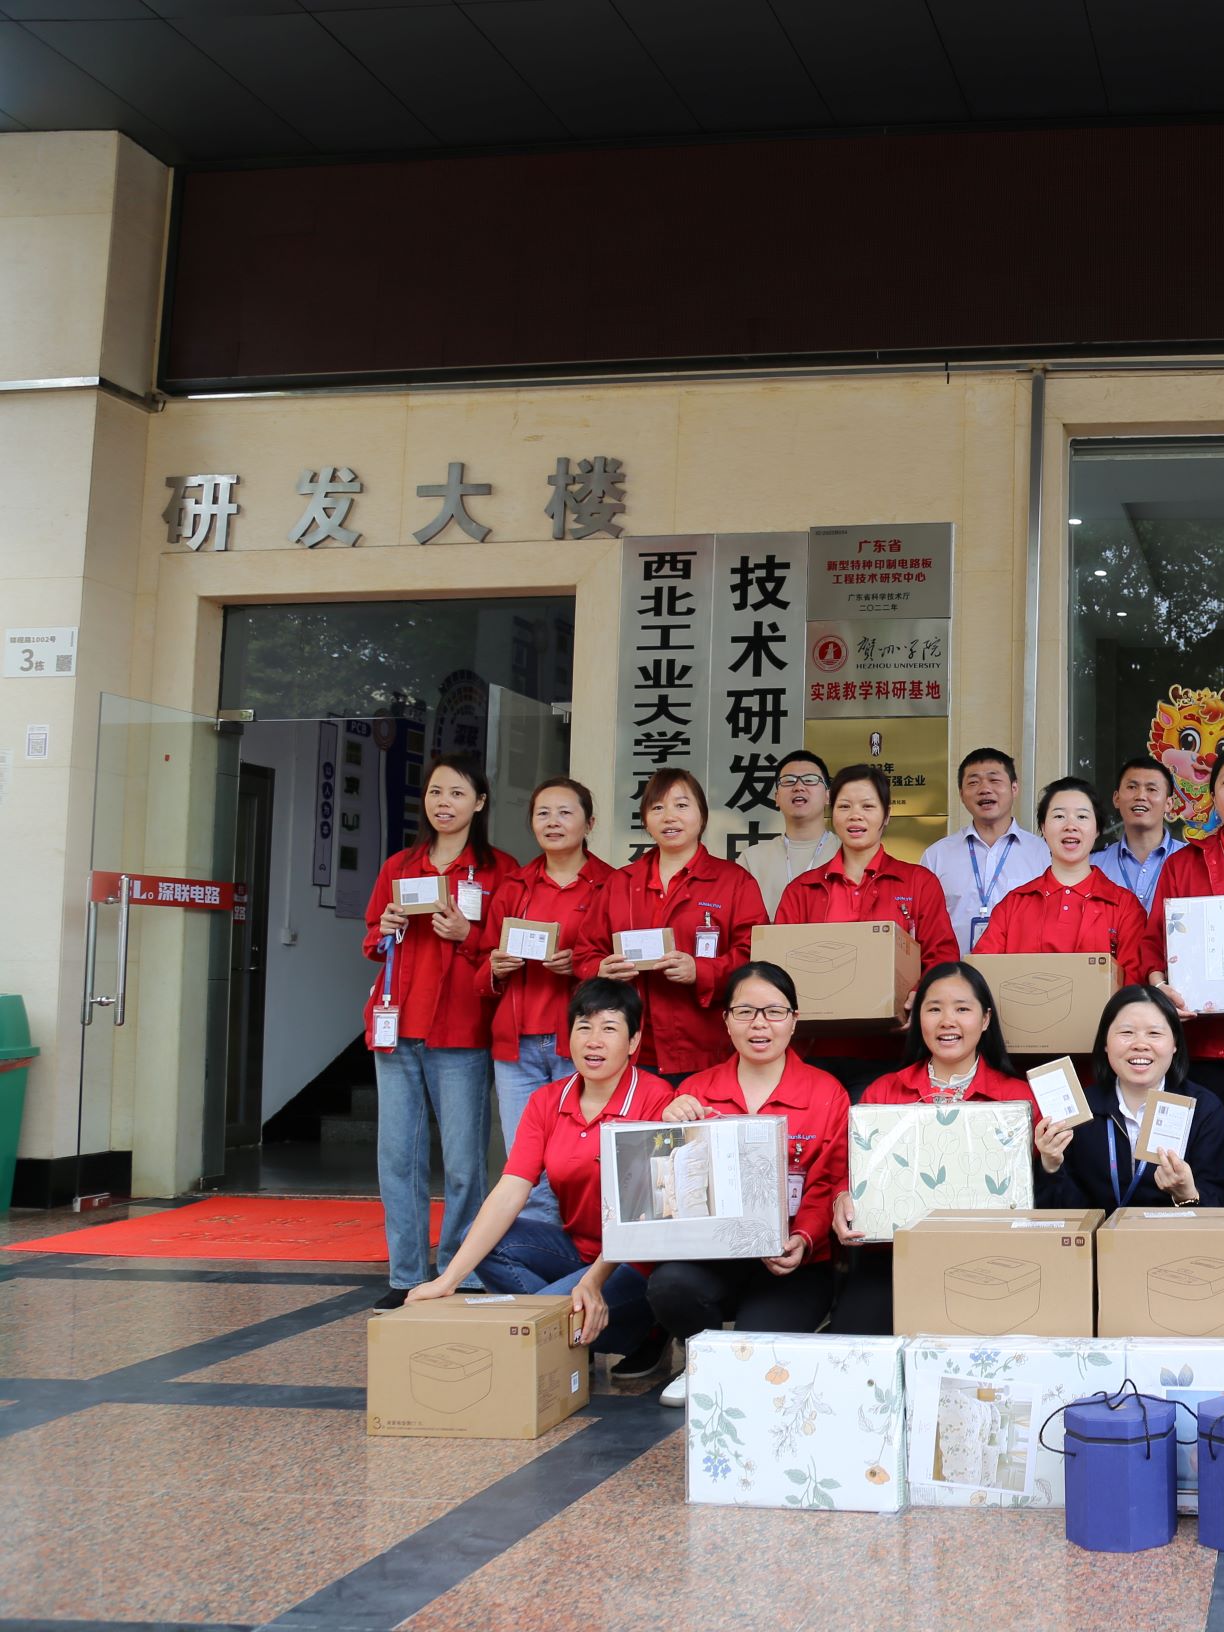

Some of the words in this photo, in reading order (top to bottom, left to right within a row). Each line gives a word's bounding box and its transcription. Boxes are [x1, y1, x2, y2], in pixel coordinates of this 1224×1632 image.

[161, 456, 627, 551] 研发大楼
[857, 539, 902, 553] 广东省
[827, 558, 932, 571] 新型特种印制电路板
[832, 572, 926, 584] 工程技术研究中心
[848, 592, 910, 601] 广东省科学技术厅
[811, 680, 941, 701] 实践教学科研基地
[629, 551, 697, 862] 西北工业大学
[158, 882, 221, 904] 深联电路
